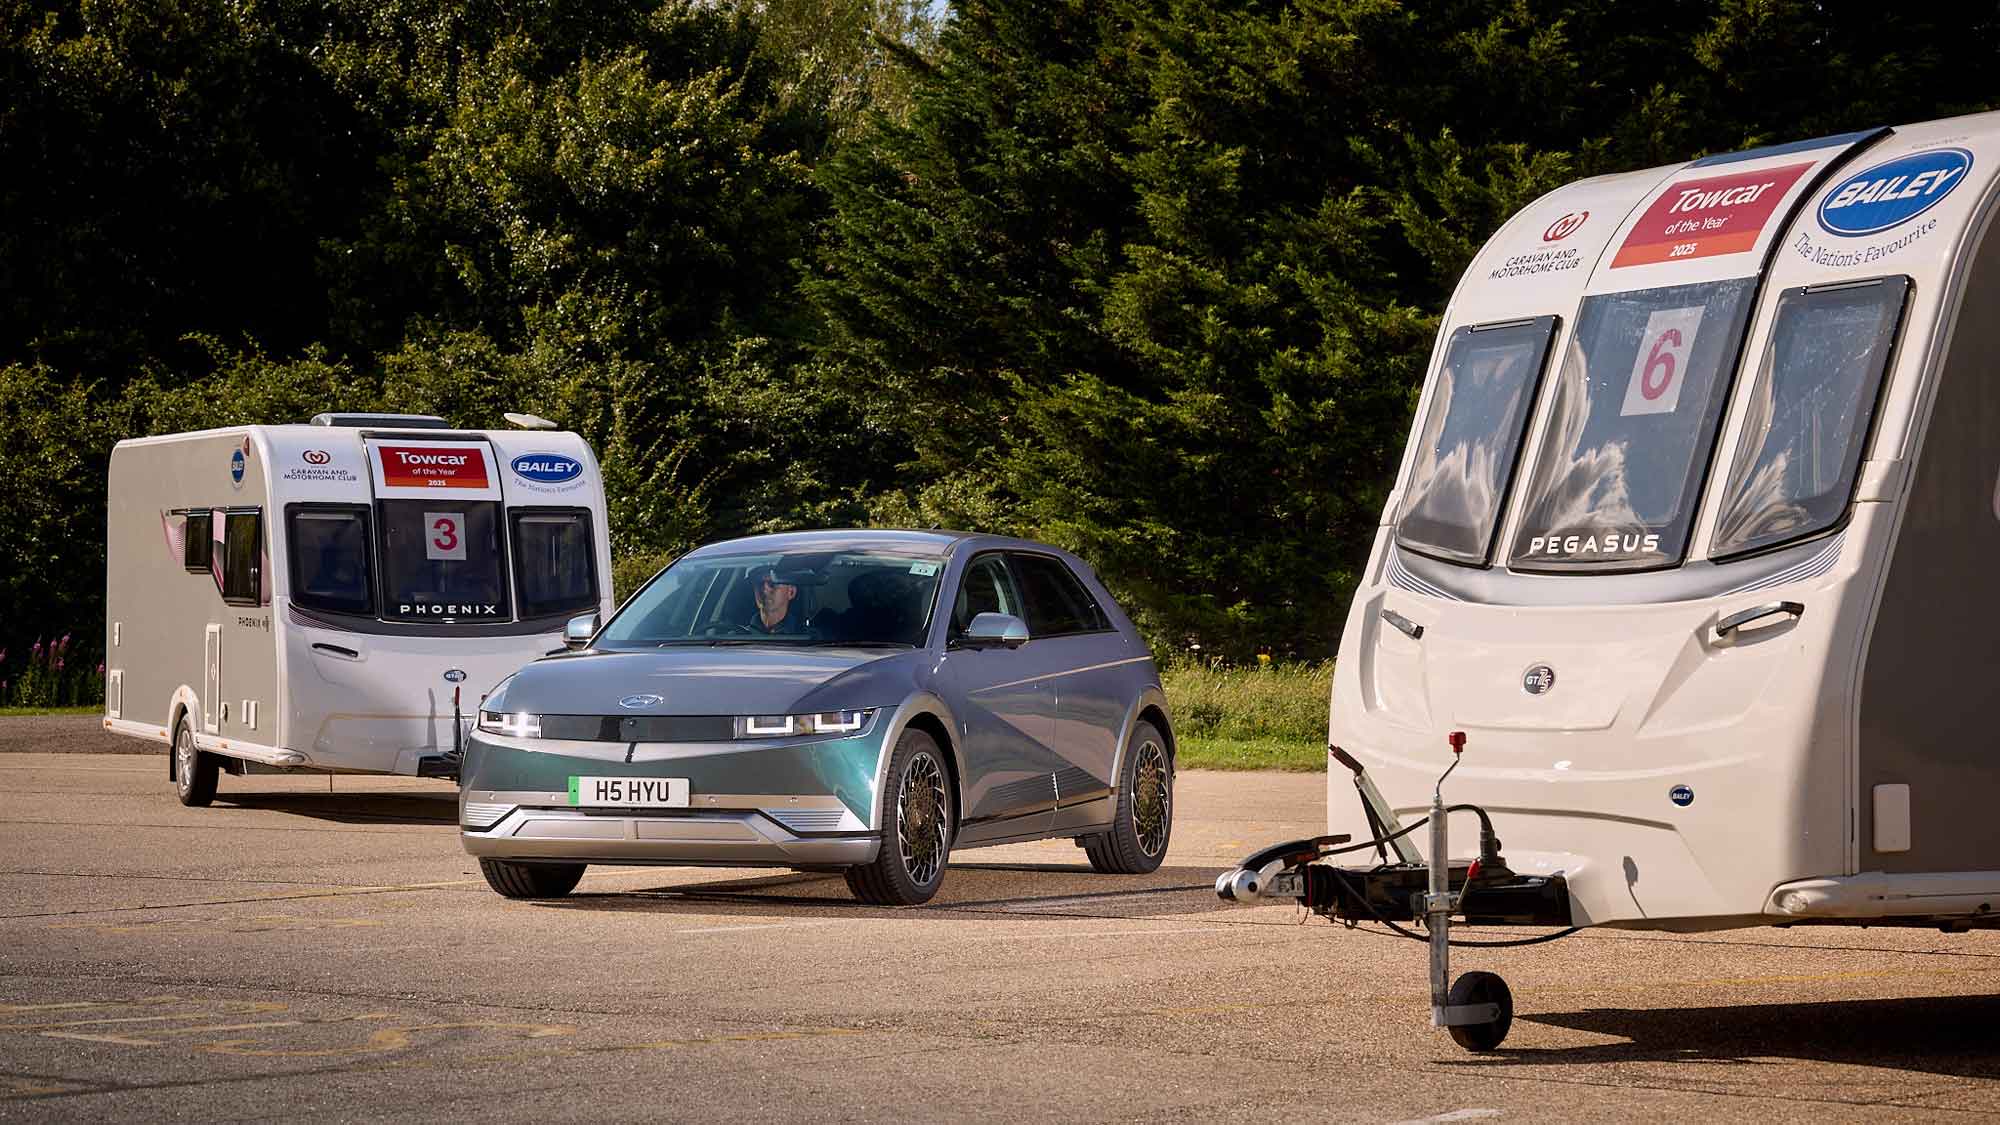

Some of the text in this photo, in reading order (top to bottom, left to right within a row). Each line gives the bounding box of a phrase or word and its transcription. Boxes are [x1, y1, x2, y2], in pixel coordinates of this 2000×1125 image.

[1670, 182, 1775, 214] Towcar
[1826, 166, 1963, 210] BAILEY
[1664, 216, 1729, 235] of the Year
[1669, 243, 1698, 257] 2025
[1794, 218, 1937, 267] The Nation's Favourite
[1506, 248, 1577, 267] CARAVAN AND
[1488, 258, 1580, 280] MOTORHOME CLUB
[1641, 328, 1682, 401] 6
[395, 452, 467, 465] Towcar
[517, 462, 576, 473] BAILEY
[433, 518, 458, 551] 3
[1529, 534, 1660, 554] PEGASUS
[400, 605, 496, 614] PHOENIX
[596, 780, 669, 802] H5 HYU
